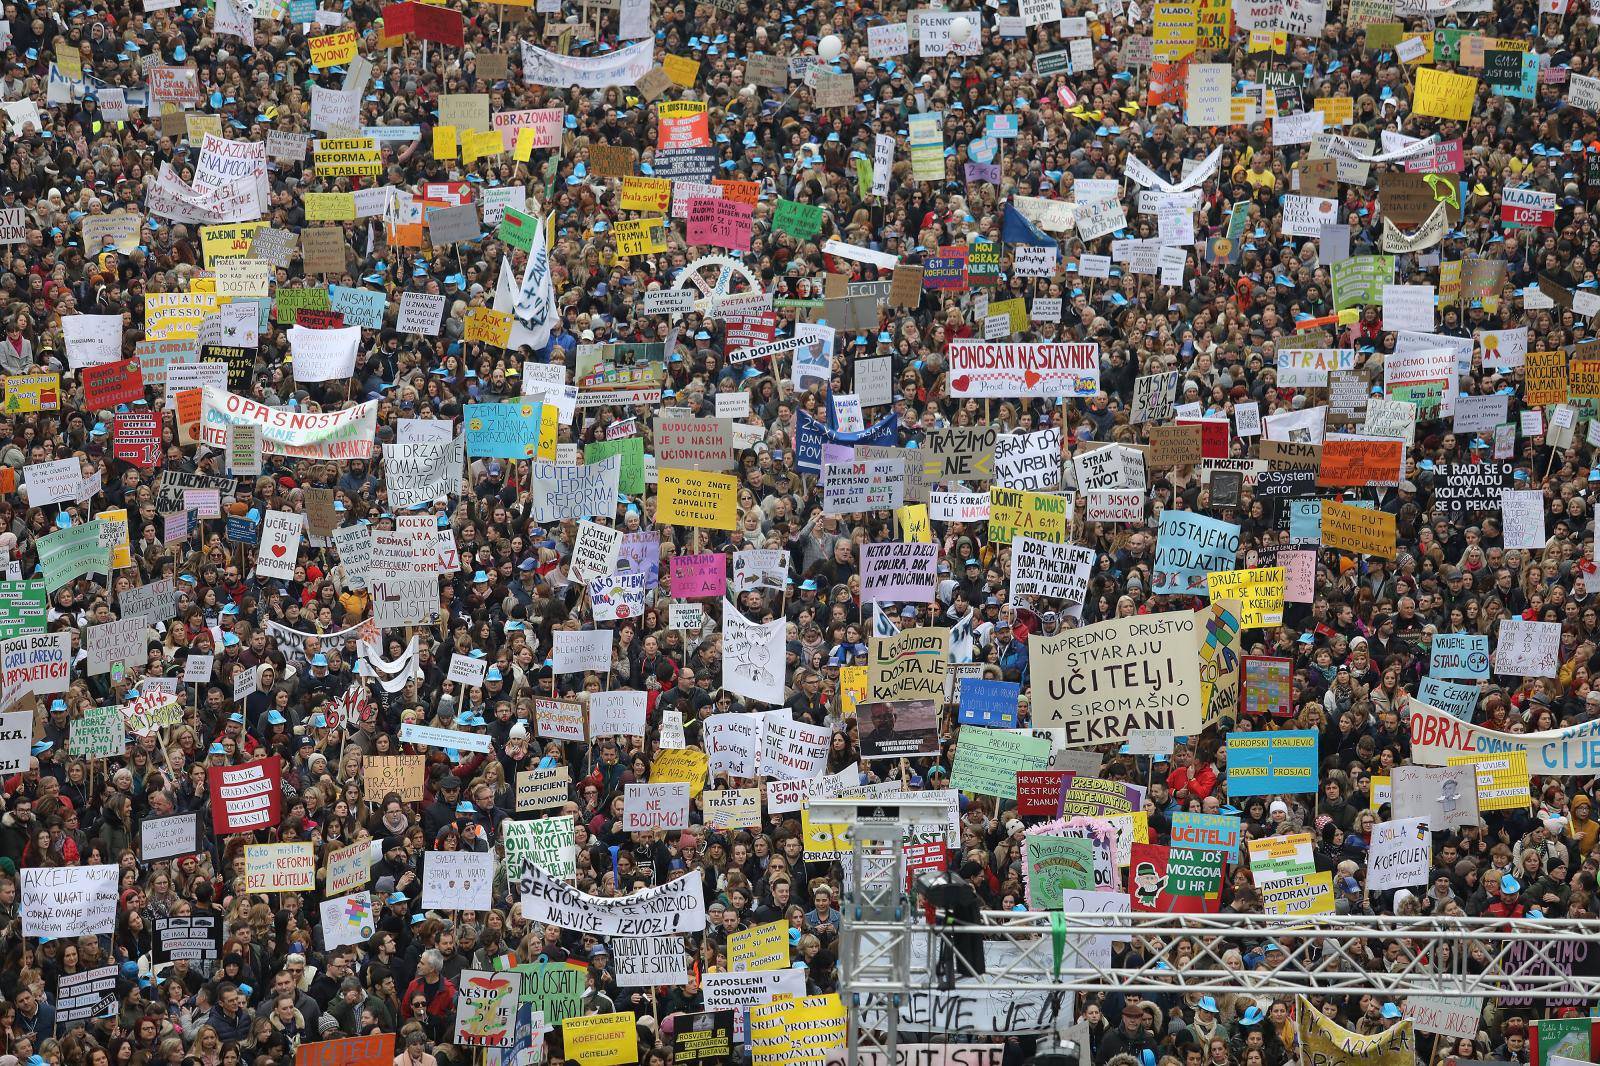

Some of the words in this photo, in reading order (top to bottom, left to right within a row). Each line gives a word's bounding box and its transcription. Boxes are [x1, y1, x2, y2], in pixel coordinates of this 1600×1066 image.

[1160, 7, 1192, 15] VLADO,
[1289, 12, 1312, 25] NAS
[308, 36, 336, 48] KOME
[313, 49, 350, 63] ZVONI?
[1263, 71, 1295, 86] HVALA
[495, 112, 562, 126] OBRAZOVANJE
[362, 139, 373, 149] JE
[317, 167, 329, 176] NE
[333, 166, 382, 176] TABLET!!!
[1503, 191, 1540, 205] VLADA
[616, 222, 639, 232] ČEKAM
[624, 241, 642, 253] 6.11
[975, 243, 993, 253] MOJ
[948, 259, 958, 268] JE
[968, 253, 999, 263] OBRAZ
[925, 268, 963, 277] KOEFICIJENT
[968, 264, 985, 273] NIJE
[987, 263, 998, 272] NA
[340, 294, 374, 304] NISAM
[404, 293, 443, 301] INVESTICIJA
[682, 290, 691, 298] SU
[404, 309, 439, 317] ISPLAĆUJE
[407, 317, 434, 325] NAJVEĆE
[473, 313, 500, 327] LAJK
[731, 351, 747, 362] NA
[750, 336, 817, 357] DOPUNSKU!
[952, 345, 1014, 369] PONOSAN
[1017, 345, 1096, 370] NASTAVNIK
[1526, 354, 1561, 366] NAJVEĆI
[1525, 366, 1565, 378] KVOCIJENT
[1525, 378, 1563, 390] NAJMANJI
[1526, 391, 1566, 403] KOEFICIJENT
[471, 405, 518, 418] ZEMLJA
[488, 420, 528, 431] ZNANJA
[606, 426, 636, 438] RATNICI
[927, 428, 996, 454] TRAŽIMO
[994, 433, 1033, 461] ŠTRAJK
[1277, 444, 1315, 456] NEMA
[598, 460, 615, 472] SU
[995, 464, 1013, 480] NA
[1016, 457, 1046, 475] VRBI
[1082, 455, 1112, 469] ŠTRAJK
[1215, 459, 1253, 470] MOŽEMO!
[1432, 464, 1448, 475] NE
[1452, 464, 1478, 474] RADI
[1484, 464, 1498, 474] SE
[1502, 463, 1512, 474] O
[555, 475, 605, 492] JEDINA
[1084, 472, 1119, 488] ŽIVOT
[1447, 475, 1502, 487] KOMADU
[48, 485, 75, 495] TODAY
[677, 488, 720, 499] PROČITATI
[1434, 485, 1482, 498] KOLAČA.
[546, 488, 612, 506] REFORMA
[672, 498, 718, 509] ZAHVALITE
[990, 491, 1023, 509] UČINITE
[1034, 498, 1064, 513] DANAS
[1107, 496, 1139, 507] BISMO
[1435, 501, 1449, 512] SE
[1452, 501, 1462, 511] O
[1014, 510, 1033, 526] ZA
[1088, 508, 1143, 521] KOMUNICIRALI!
[1327, 506, 1350, 520] OVAJ
[1361, 514, 1383, 526] PUT
[1330, 520, 1384, 539] PAMETNIJI
[274, 532, 287, 544] SU
[1168, 520, 1239, 553] OSTAJEMO
[1323, 530, 1335, 544] NE
[579, 535, 612, 553] ŠKOLSKI
[577, 547, 606, 564] PRIBOR
[866, 545, 890, 557] NETKO
[1052, 547, 1090, 566] VRIJEME
[258, 557, 295, 572] REFORME
[912, 559, 929, 570] DOK
[1017, 555, 1036, 566] KADA
[1039, 559, 1076, 573] PAMETAN
[1168, 547, 1234, 572] ODLAZITE
[889, 572, 935, 586] POUČAVAMO
[1046, 573, 1074, 587] BUDALA
[1209, 574, 1241, 587] DRUŽE
[1248, 570, 1284, 584] PLENKI
[1238, 587, 1248, 598] SE
[1254, 585, 1283, 597] KUNEM
[1040, 627, 1116, 656] NAPREDNO
[1129, 618, 1193, 637] DRUŠTVO
[5, 639, 28, 651] BOGU
[1436, 639, 1465, 650] VRIJEME
[1470, 639, 1483, 649] JE
[1067, 640, 1162, 668] STVARAJU
[5, 654, 27, 668] CARU
[926, 660, 945, 674] JE
[1433, 655, 1460, 669] STALO
[7, 665, 48, 684] PROSVJETI
[880, 662, 922, 683] DOSTA
[1048, 659, 1184, 700] UČITELJI,
[874, 677, 945, 700] KARNEVALA
[1424, 684, 1437, 696] NE
[1443, 687, 1476, 700] ČEKAM
[1072, 693, 1190, 717] SIROMAŠNO
[1271, 737, 1314, 746] KRALJEVIĆ
[528, 769, 557, 781] #ŽELIM
[1228, 767, 1268, 776] HRVATSKI
[1273, 767, 1311, 776] PROSJACI
[1018, 775, 1061, 784] HRVATSKA
[518, 780, 568, 794] KOEFICIJENT
[226, 798, 255, 810] ODGOJ
[540, 793, 568, 805] NJONJO
[646, 800, 661, 811] NE
[629, 808, 684, 827] BOJIMO!
[507, 824, 527, 836] AKO
[1172, 826, 1237, 848] UČITELJI
[507, 839, 530, 851] OVO
[1170, 849, 1194, 861] IMA
[1199, 850, 1223, 862] JOŠ
[277, 857, 314, 869] REFORMU
[1166, 864, 1222, 878] MOZGOVA
[247, 874, 266, 887] BEZ
[1264, 877, 1309, 889] ANDREJ,
[1264, 885, 1328, 901] POZDRAVLJA
[641, 895, 697, 914] PROIZVOD
[547, 910, 603, 931] NAJVIŠE
[654, 937, 684, 954] DANAS
[615, 957, 637, 973] NAŠE
[651, 956, 686, 973] SUTRA!
[706, 977, 763, 987] ZAPOSLENI
[460, 987, 497, 999] NEŠTO
[713, 986, 767, 996] OSNOVNIM
[757, 1001, 794, 1016] JUTROS
[752, 1018, 785, 1030] SRELA
[573, 1032, 625, 1045] KOEFICIJENT
[752, 1034, 789, 1046] NAKON
[579, 1049, 618, 1059] UČITELJA?
